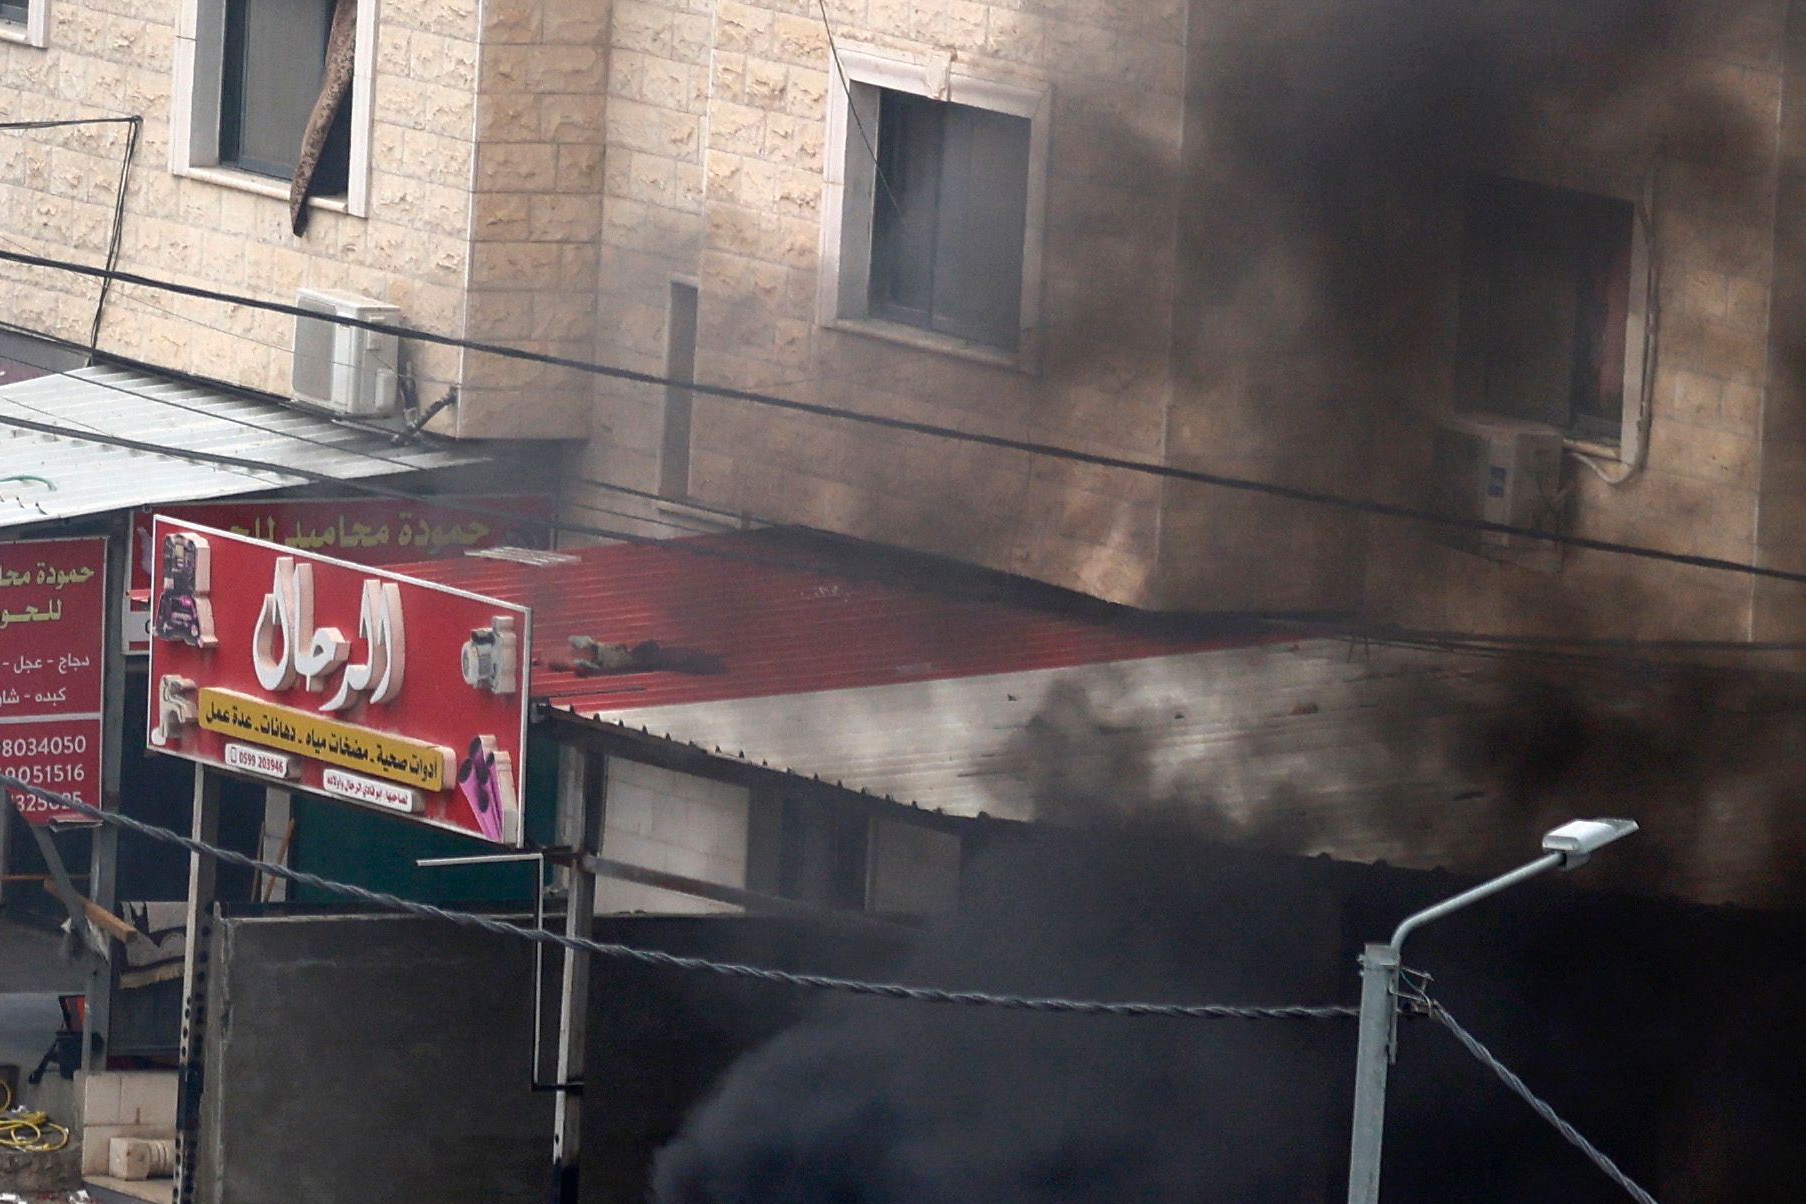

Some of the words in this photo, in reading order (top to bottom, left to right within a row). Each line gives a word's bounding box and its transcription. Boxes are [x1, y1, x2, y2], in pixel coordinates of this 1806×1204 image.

[397, 511, 491, 554] حمودة
[36, 561, 95, 590] حمودة
[13, 655, 43, 674] عجل
[58, 653, 90, 674] دجاج
[35, 687, 67, 707] كبده
[205, 701, 231, 724] عمل
[232, 705, 253, 729] عدة
[260, 714, 296, 742] دهانات
[305, 728, 327, 754] مياه
[328, 733, 369, 761] مضخات
[238, 751, 256, 767] 0599
[258, 756, 284, 774] 203946
[376, 743, 408, 773] صحية
